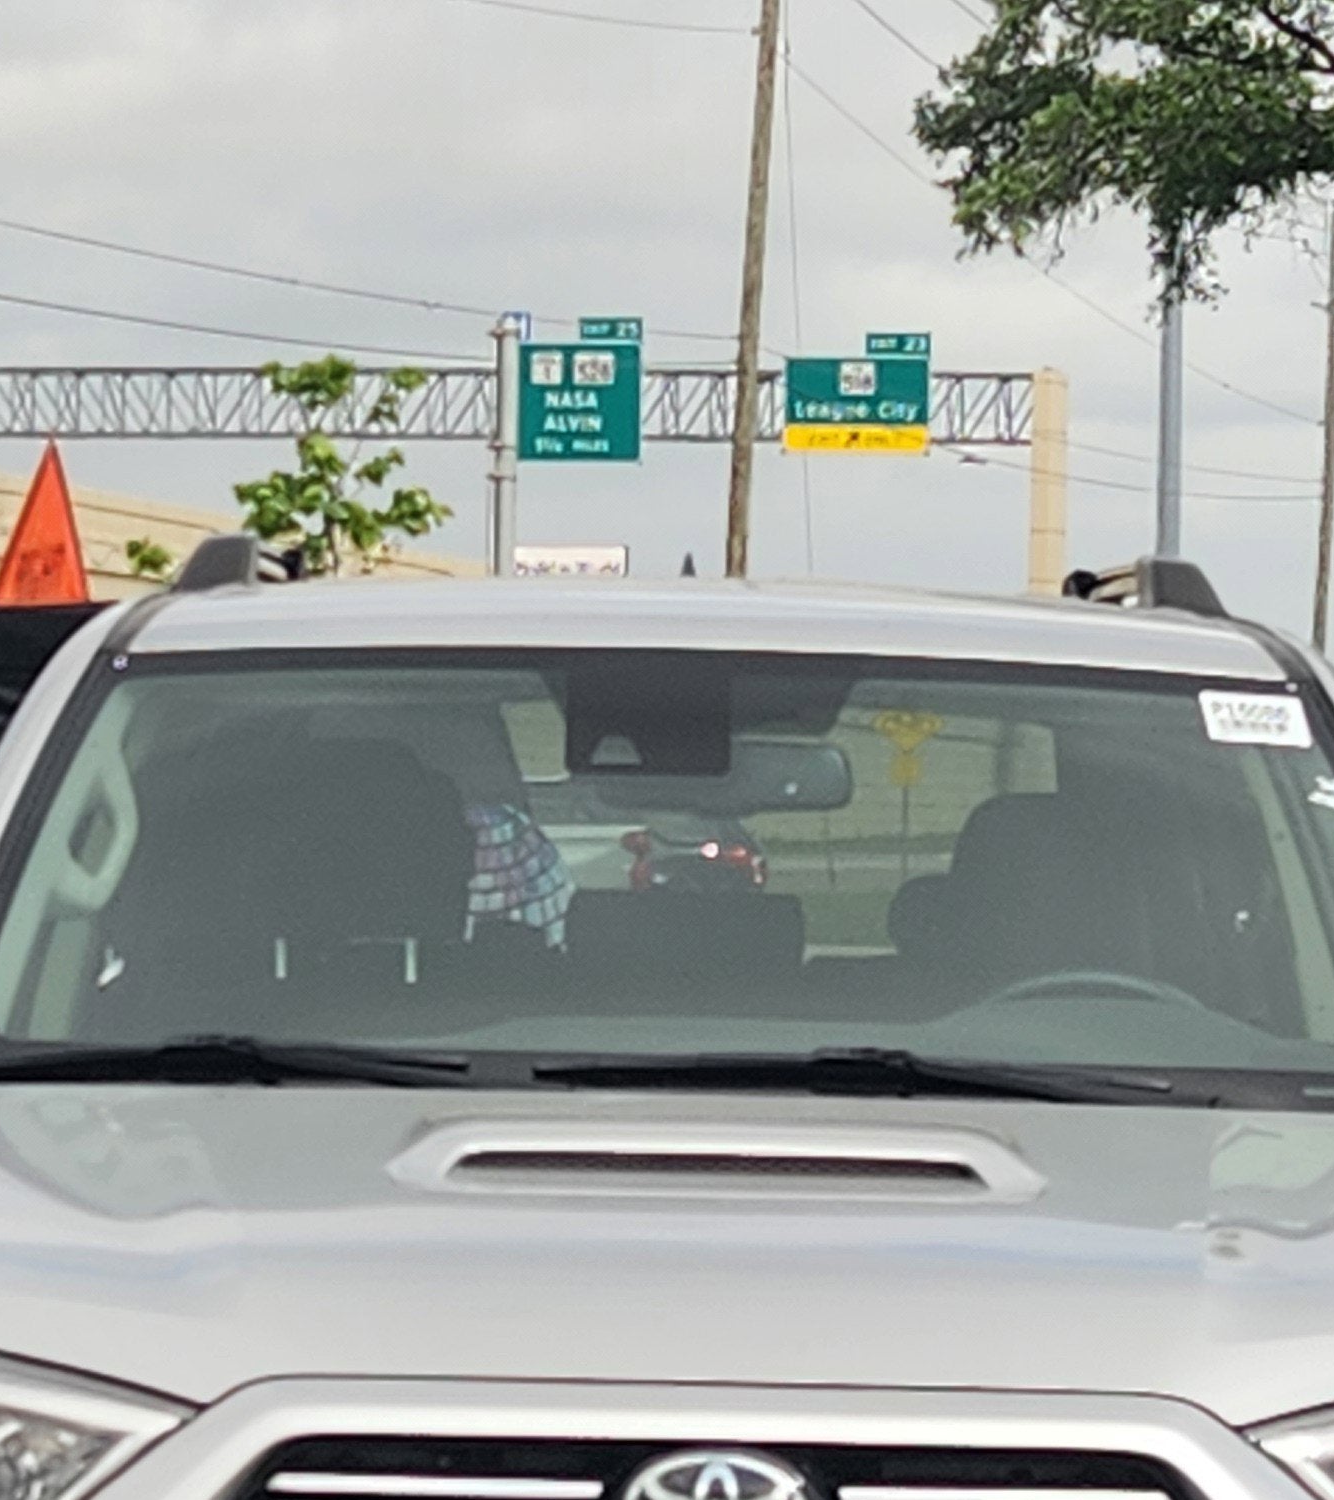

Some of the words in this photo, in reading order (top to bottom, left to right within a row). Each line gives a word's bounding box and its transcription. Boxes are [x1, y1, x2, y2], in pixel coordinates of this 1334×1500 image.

[544, 390, 598, 409] NASA
[793, 399, 870, 421] League
[877, 399, 920, 421] City
[543, 413, 603, 432] ALVIN
